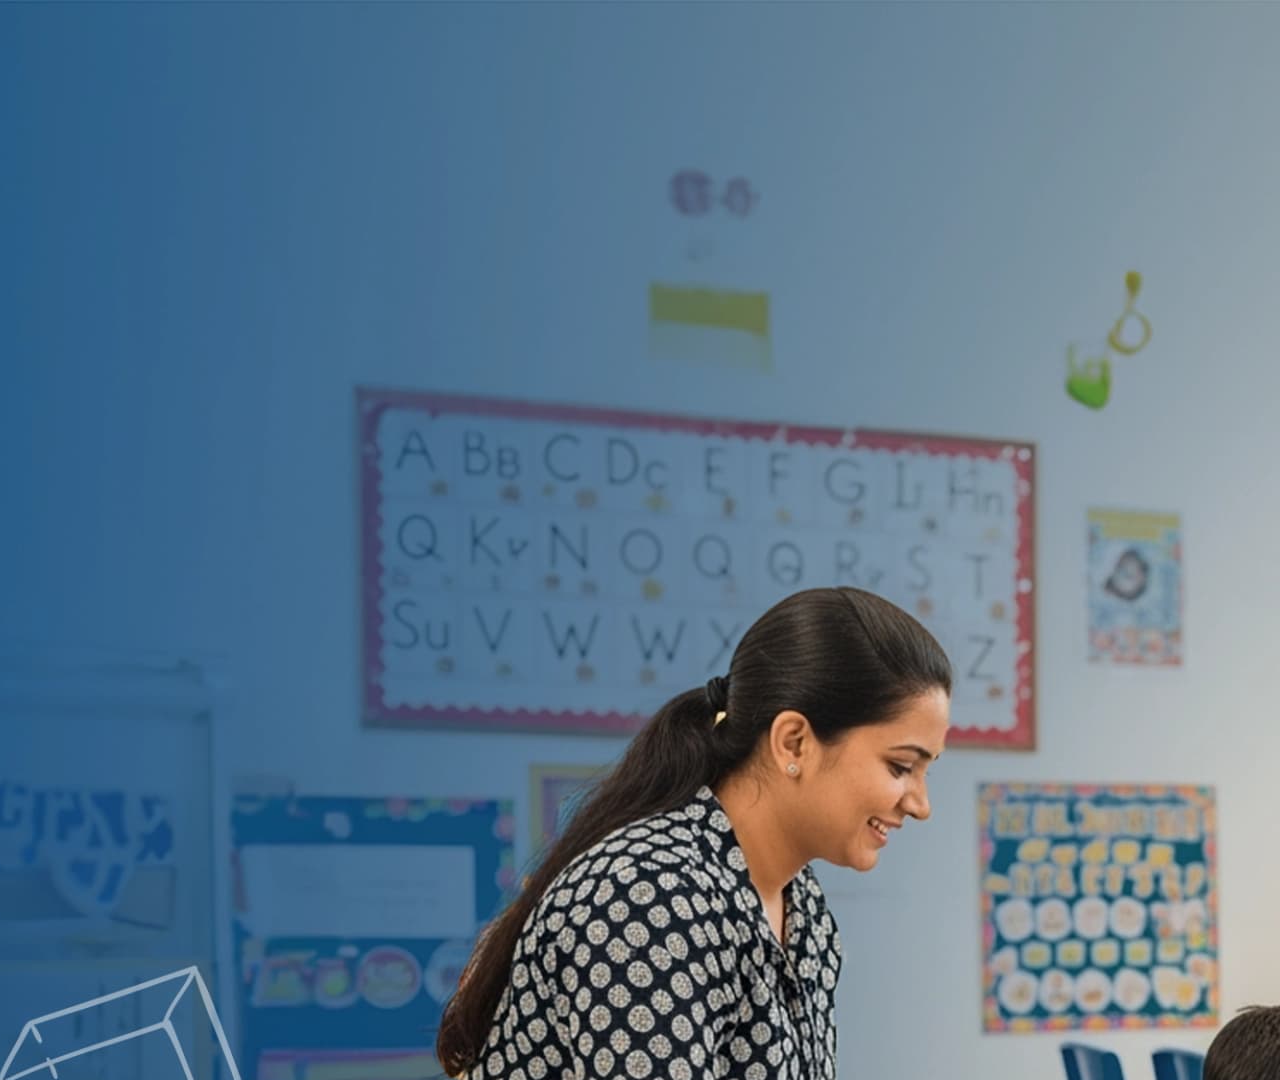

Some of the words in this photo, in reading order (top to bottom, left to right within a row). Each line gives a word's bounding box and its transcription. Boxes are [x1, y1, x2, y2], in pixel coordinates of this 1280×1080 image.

[395, 429, 436, 471] A
[543, 432, 581, 483] C
[704, 446, 729, 497] E
[769, 450, 792, 497] F
[823, 457, 868, 505] G
[397, 514, 444, 562] Q
[548, 521, 589, 571] N
[620, 528, 663, 576] O
[692, 534, 733, 581] Q
[908, 545, 933, 593] S
[965, 553, 990, 600] T
[474, 605, 512, 655] V
[542, 608, 600, 661] W
[629, 612, 687, 663] W
[966, 634, 997, 681] Z
